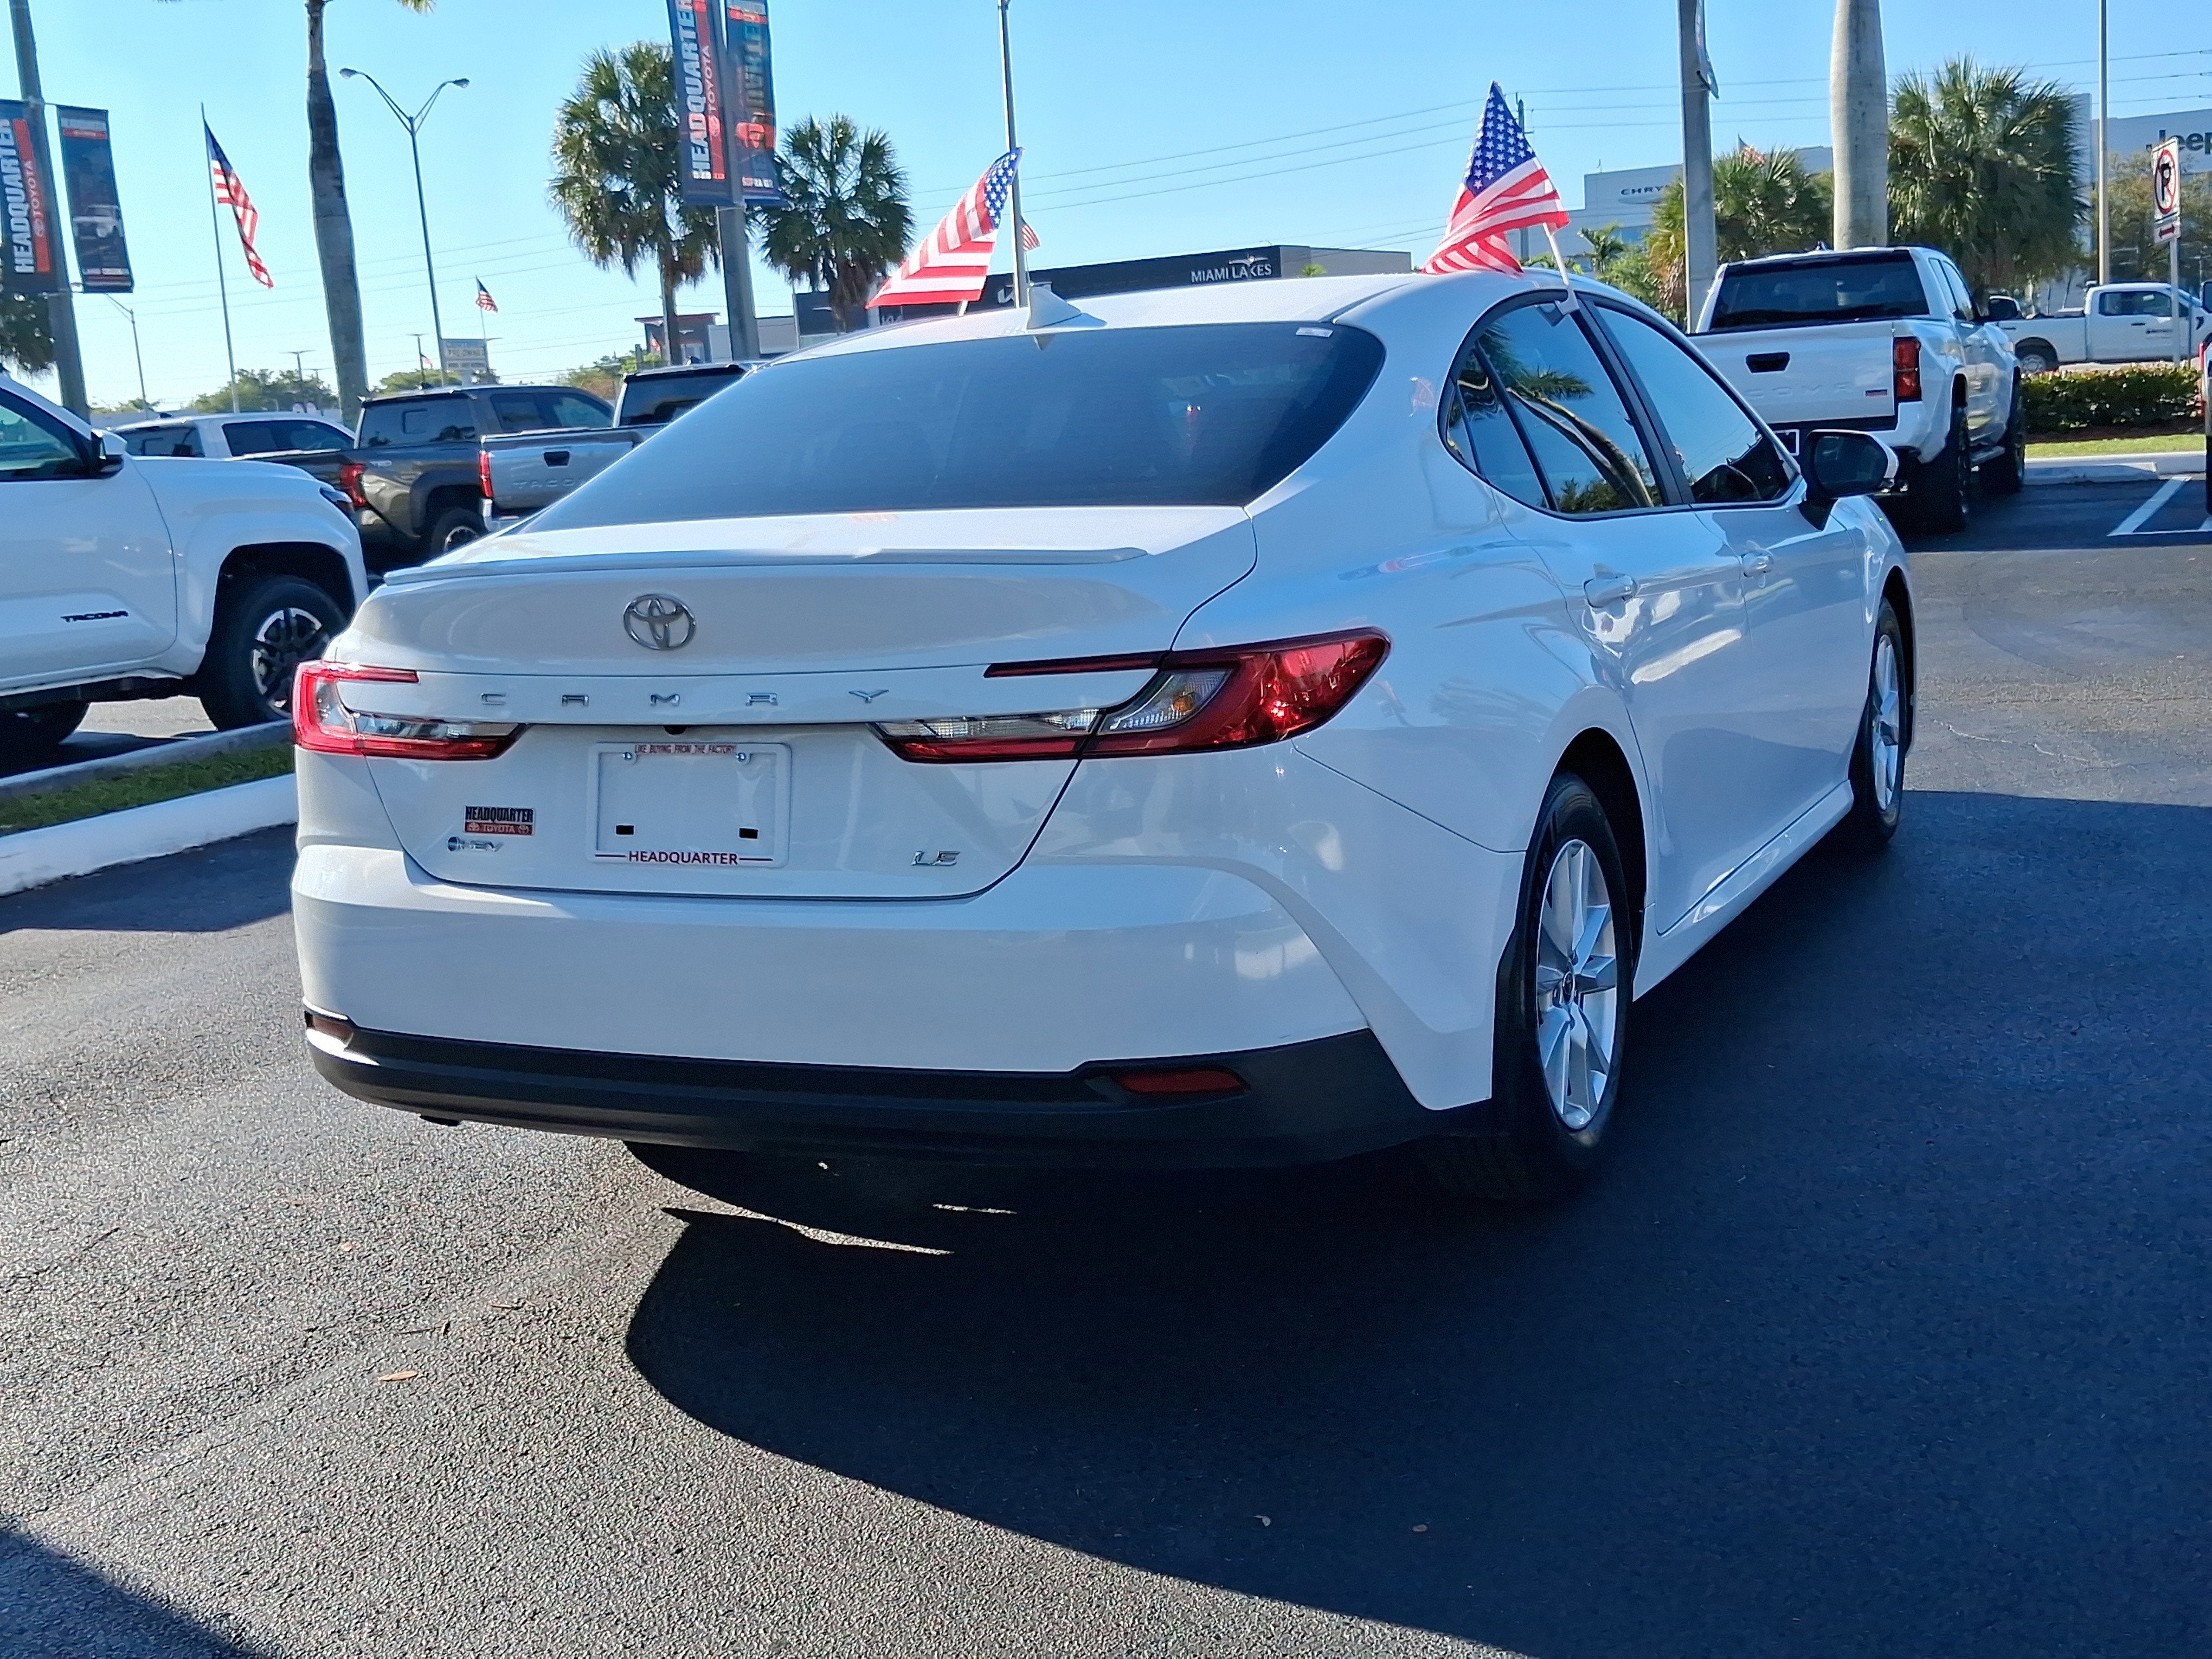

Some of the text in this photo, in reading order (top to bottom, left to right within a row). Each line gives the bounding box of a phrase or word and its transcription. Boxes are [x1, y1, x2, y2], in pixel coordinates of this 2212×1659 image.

[702, 46, 717, 111] TOYOTA
[675, 0, 711, 179] HEADQUARTER
[23, 161, 42, 217] TOYOTA
[1621, 185, 1668, 195] CHRY
[1191, 263, 1272, 283] MIAMI LAKES
[60, 610, 128, 622] TACOMA
[481, 690, 889, 706] CAMRY
[465, 807, 533, 822] HEADQUARTER
[483, 824, 515, 833] TOYOTA
[628, 851, 738, 865] HEADQUARTER
[911, 851, 960, 866] LE
